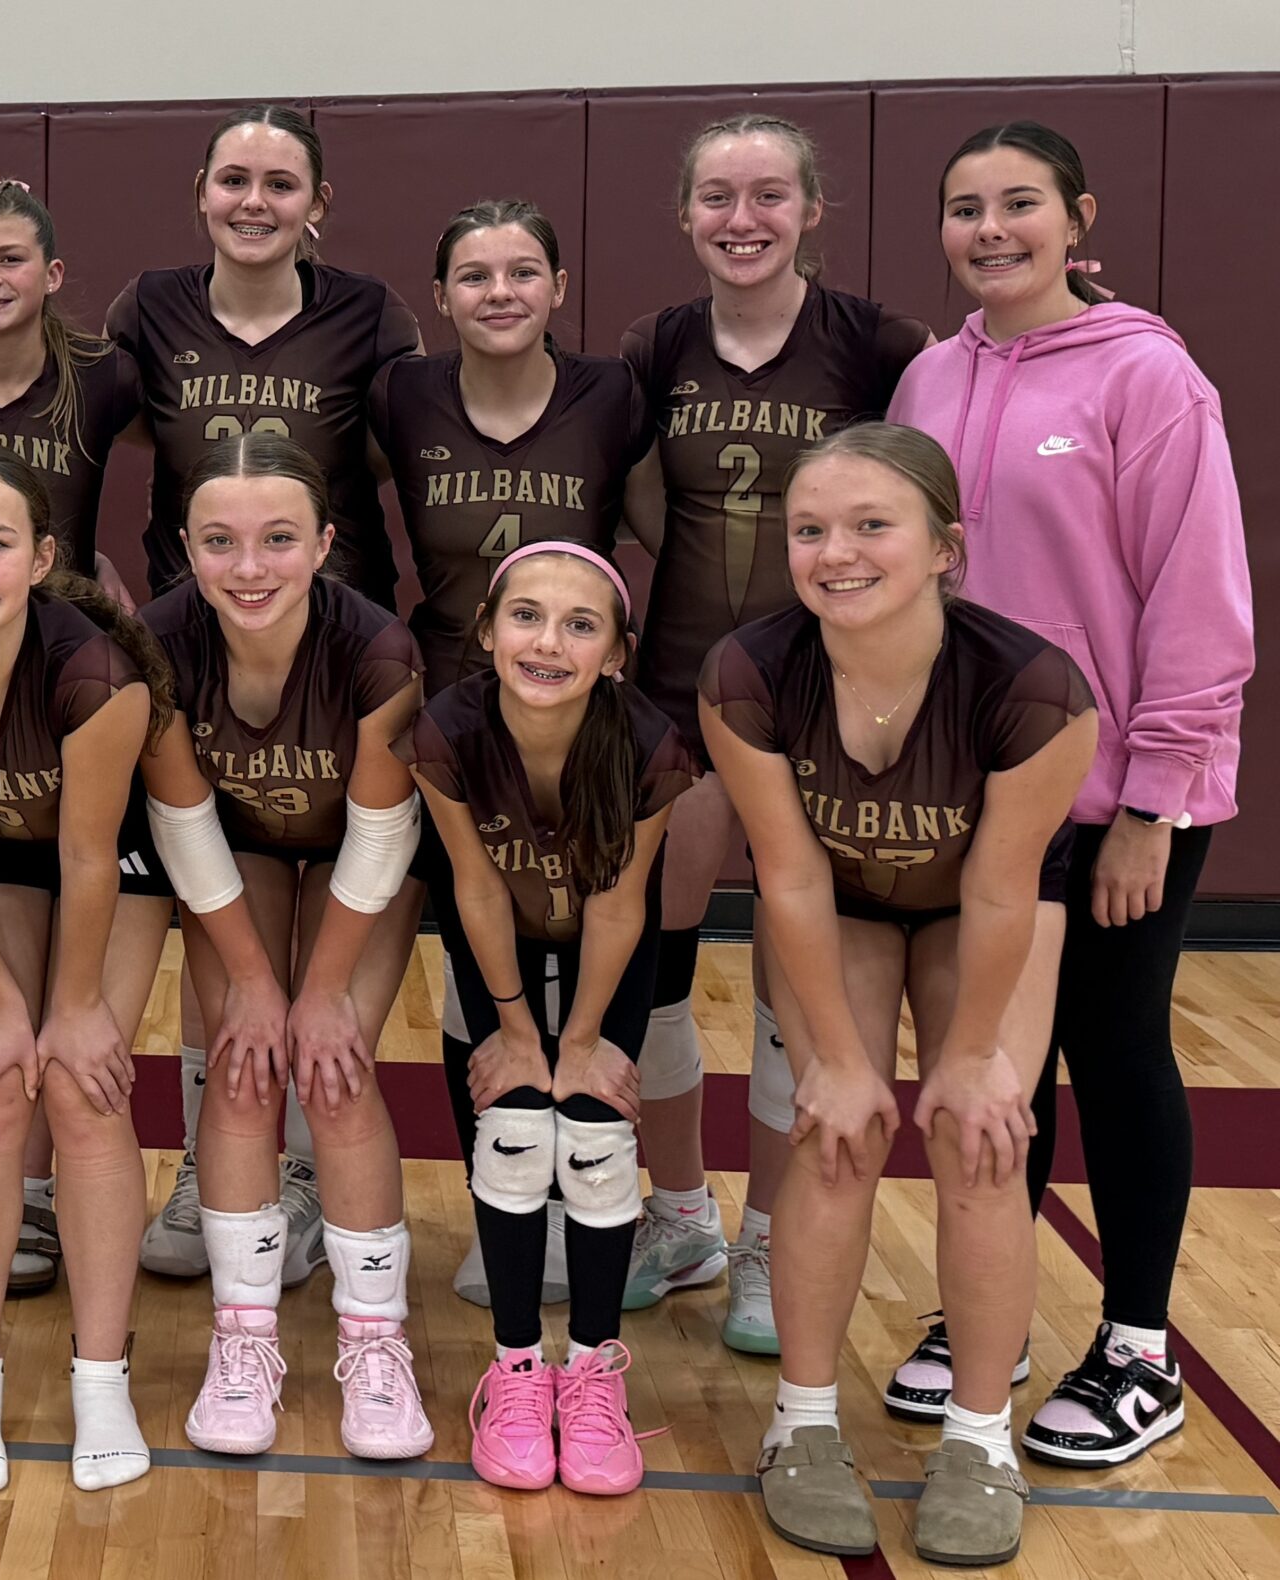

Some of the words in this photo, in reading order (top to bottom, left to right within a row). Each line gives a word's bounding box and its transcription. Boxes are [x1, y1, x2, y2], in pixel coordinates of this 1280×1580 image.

[180, 374, 322, 415] MILBANK
[667, 400, 827, 442] MILBANK
[1045, 434, 1075, 449] NIKE
[425, 469, 585, 511] MILBANK
[717, 442, 764, 513] 2
[477, 512, 523, 559] 4
[195, 743, 341, 780] ILBANK
[219, 778, 312, 816] 23
[484, 838, 572, 880] MILB
[547, 885, 576, 921] 1
